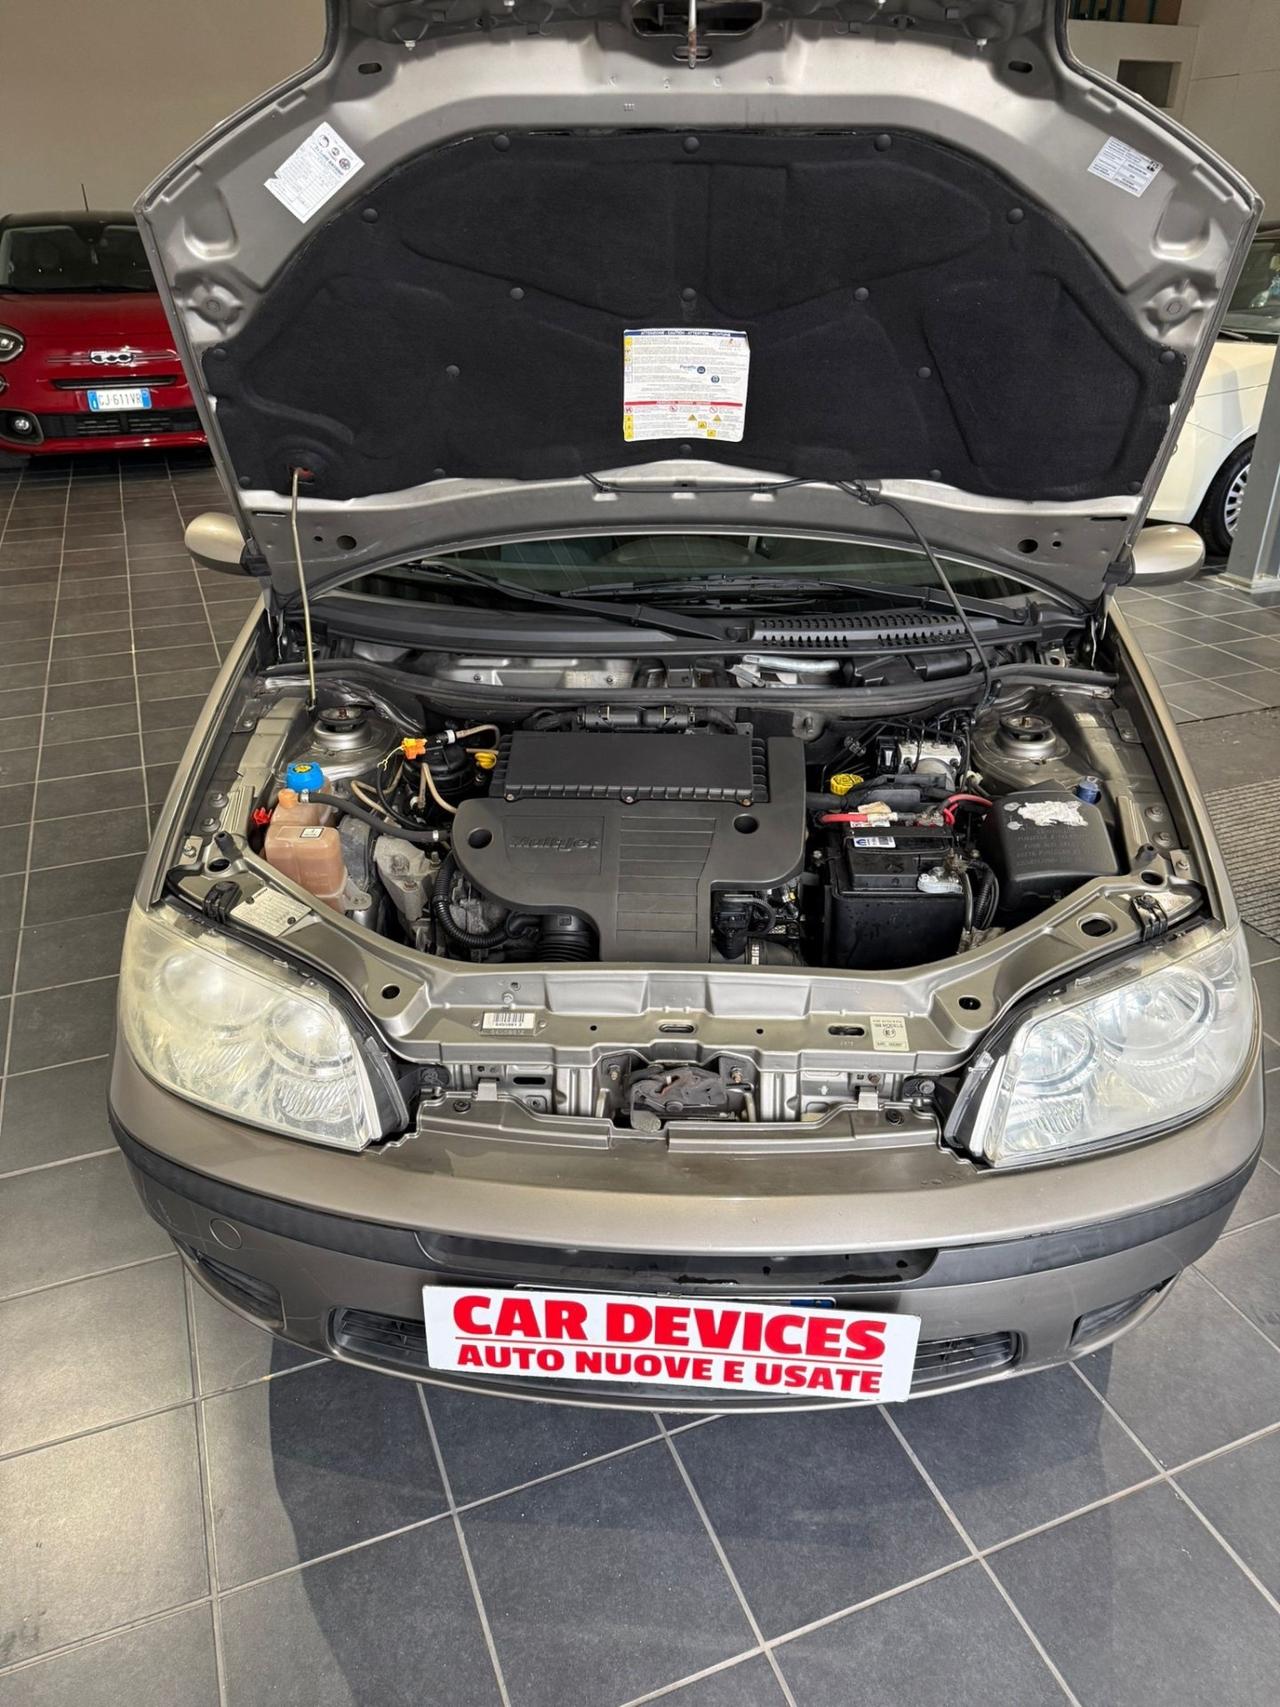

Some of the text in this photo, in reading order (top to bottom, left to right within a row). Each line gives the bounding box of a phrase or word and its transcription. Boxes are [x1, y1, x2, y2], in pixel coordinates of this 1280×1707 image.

[453, 1295, 887, 1360] CAR DEVICES
[457, 1344, 881, 1393] AUTO NUOVE E USATE
